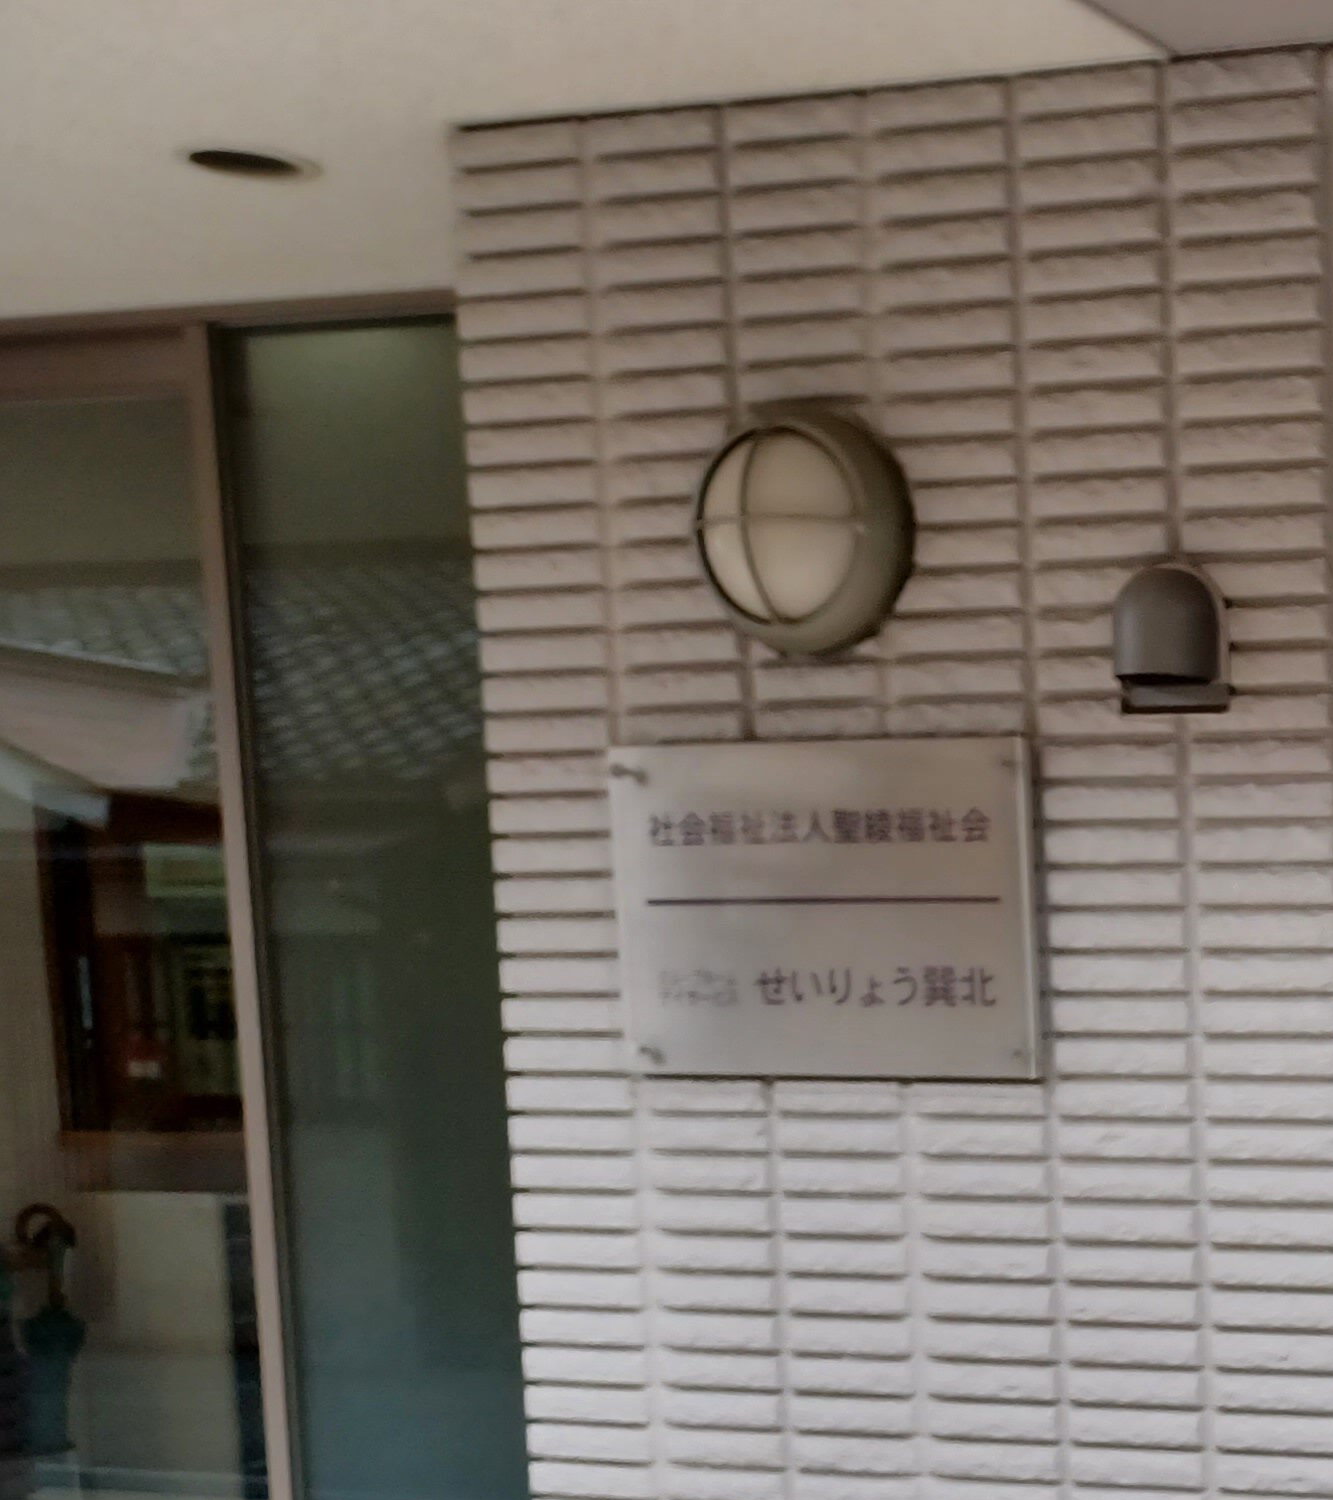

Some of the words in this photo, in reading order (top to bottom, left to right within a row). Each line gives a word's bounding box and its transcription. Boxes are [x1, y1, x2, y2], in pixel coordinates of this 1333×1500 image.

[755, 966, 997, 1009] せいりょう巽北
